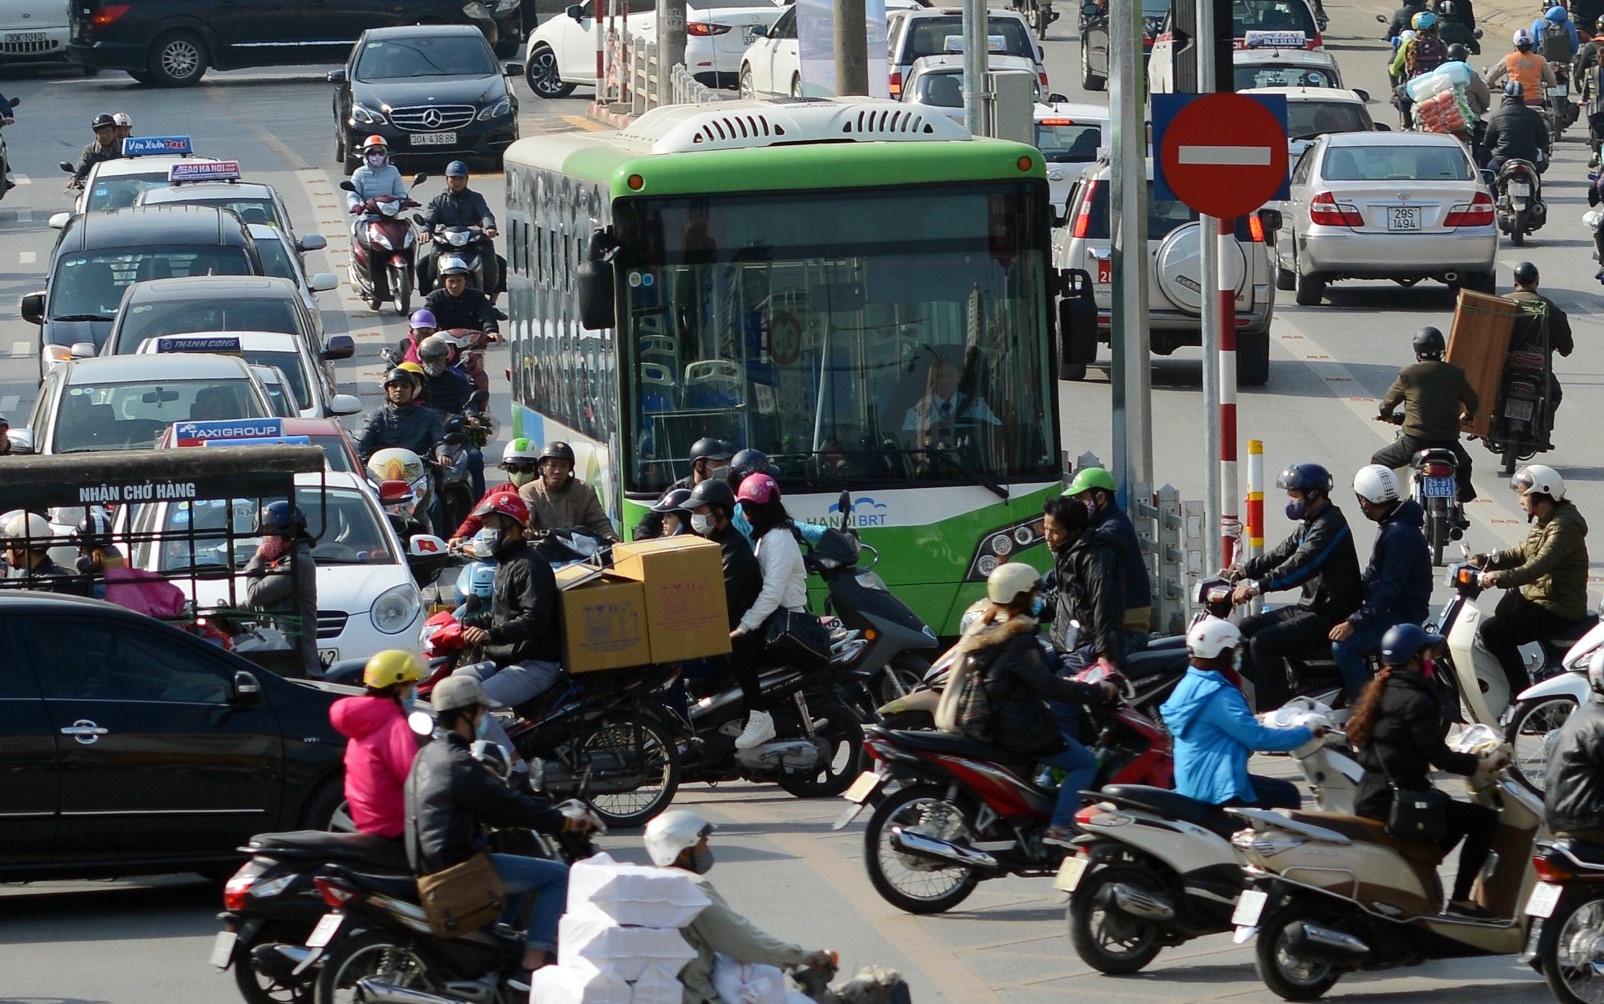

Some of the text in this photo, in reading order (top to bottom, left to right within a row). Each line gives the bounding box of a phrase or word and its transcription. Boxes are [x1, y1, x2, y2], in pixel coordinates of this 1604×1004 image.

[1394, 208, 1414, 219] 29S
[1393, 219, 1416, 229] 1494
[80, 479, 196, 504] NHẬN CHỞ HÀNG
[858, 513, 887, 527] BRT
